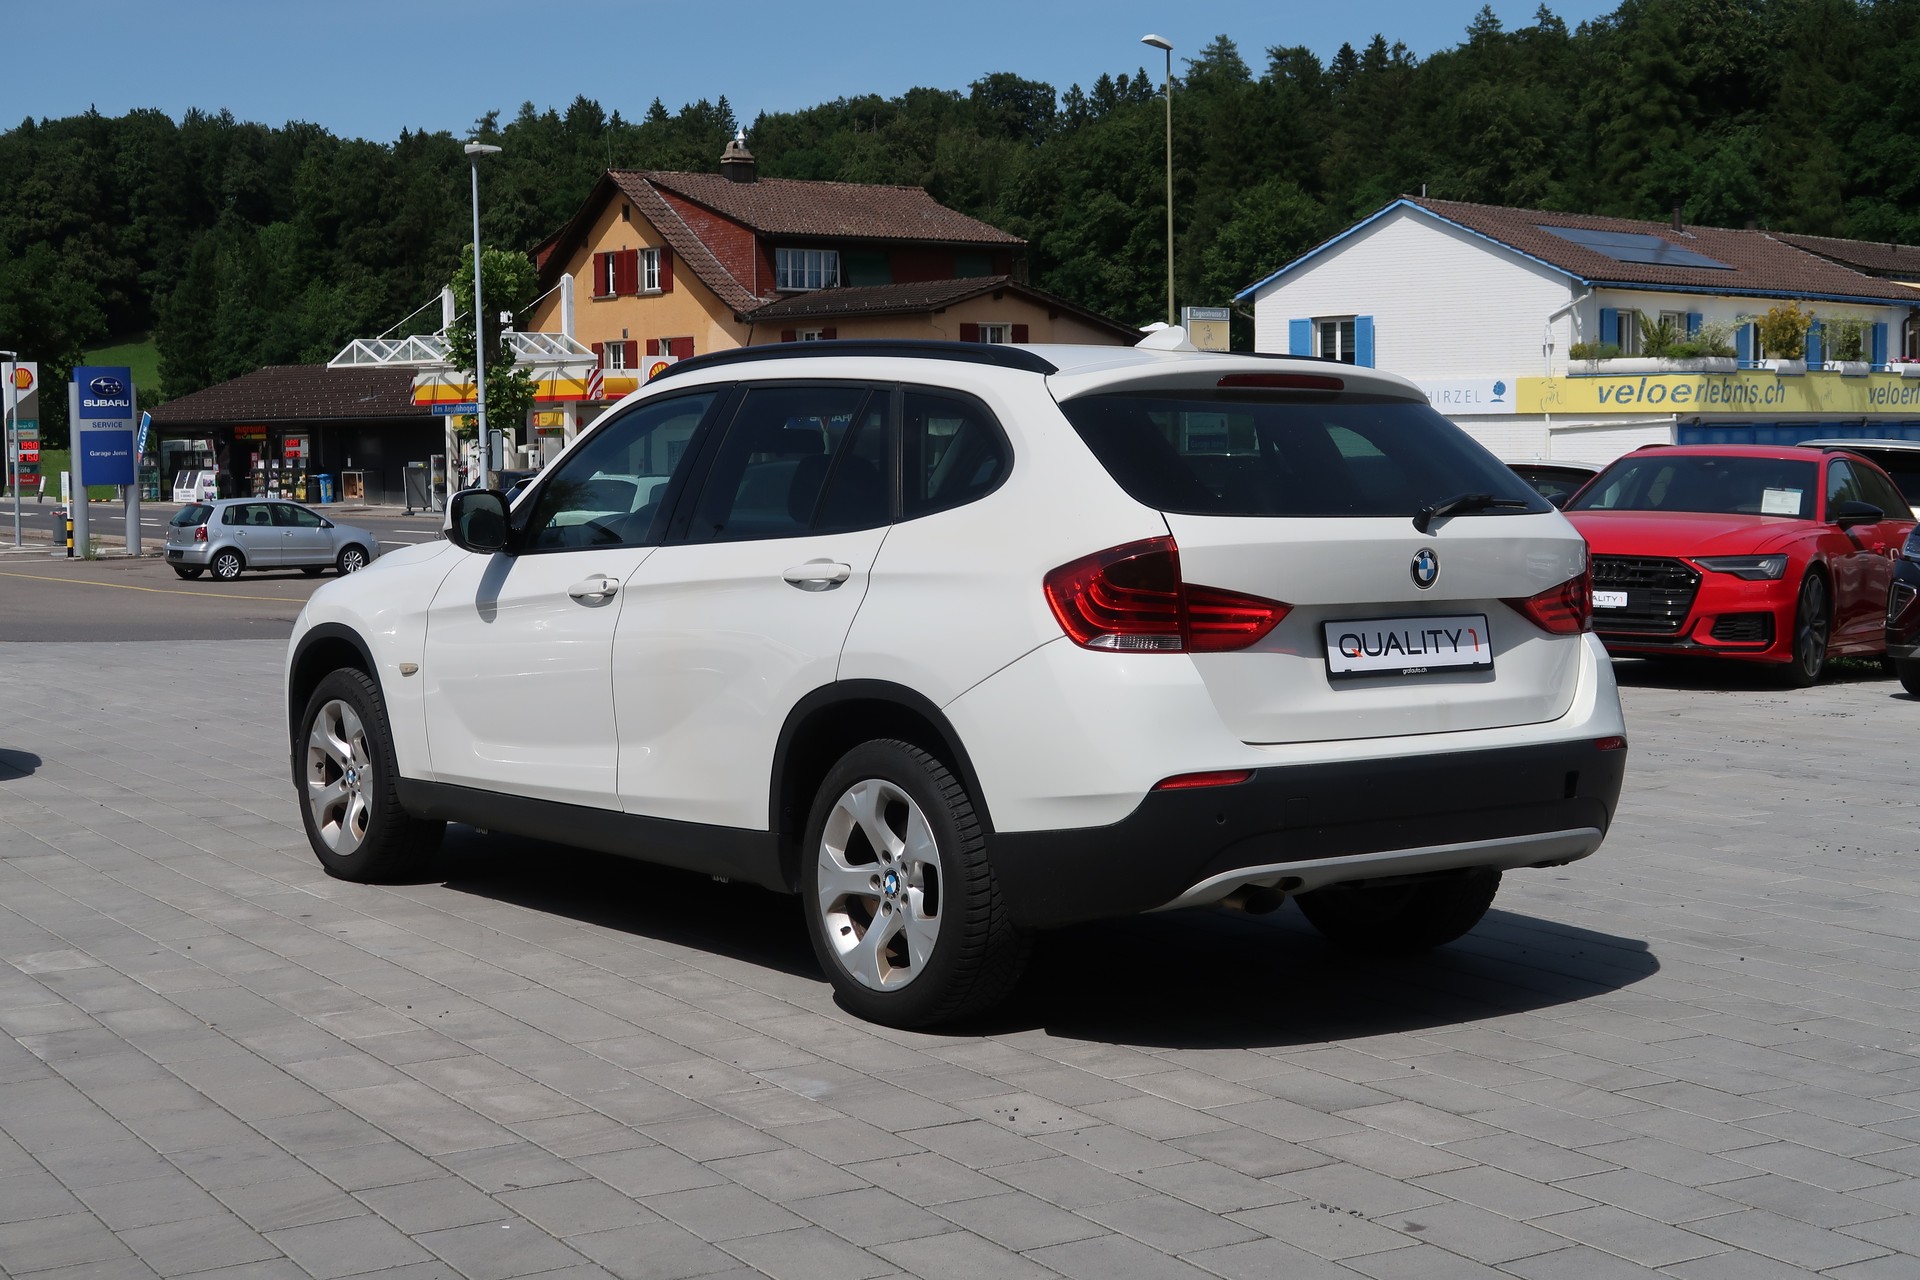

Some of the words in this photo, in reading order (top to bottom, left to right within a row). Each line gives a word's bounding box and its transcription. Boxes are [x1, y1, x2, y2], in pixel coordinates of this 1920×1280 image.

[1427, 390, 1481, 403] HIRZEL
[1598, 377, 1786, 404] veloerlebnis.ch
[83, 399, 129, 407] SUBARU
[1339, 628, 1463, 658] QUALITY
